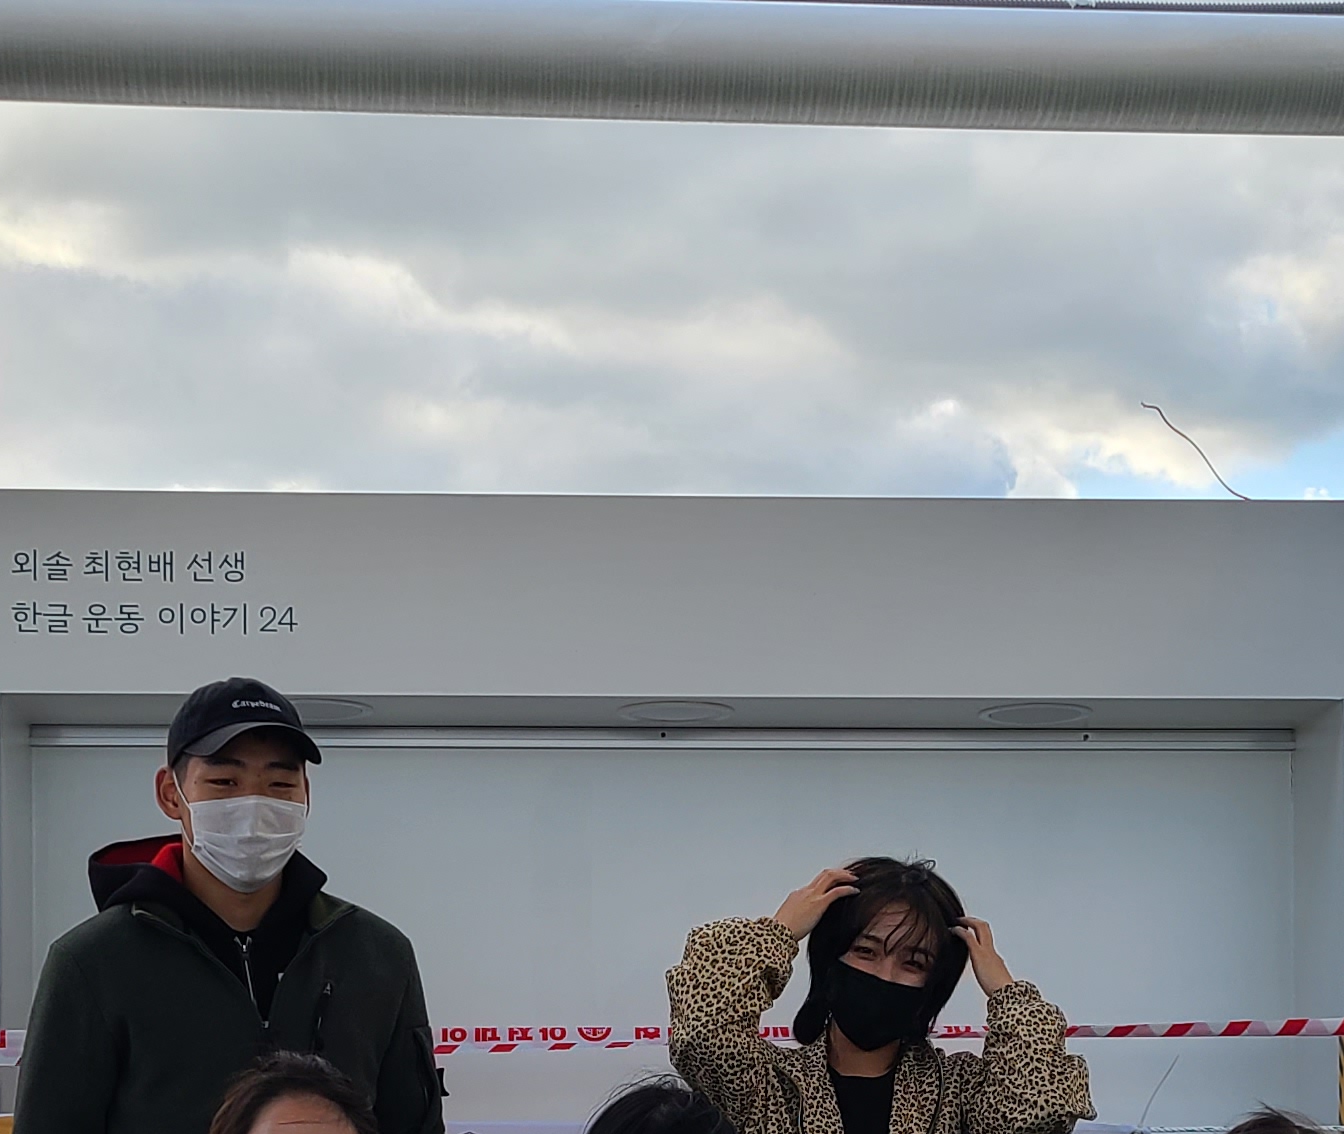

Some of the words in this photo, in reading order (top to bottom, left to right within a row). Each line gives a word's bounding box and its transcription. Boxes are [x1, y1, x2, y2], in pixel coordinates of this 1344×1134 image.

[11, 549, 73, 582] 외솔
[83, 549, 174, 583] 최현배
[186, 550, 246, 583] 선생
[11, 601, 74, 635] 한글
[82, 602, 145, 635] 운동
[158, 602, 248, 636] 이야기
[258, 606, 299, 633] 24
